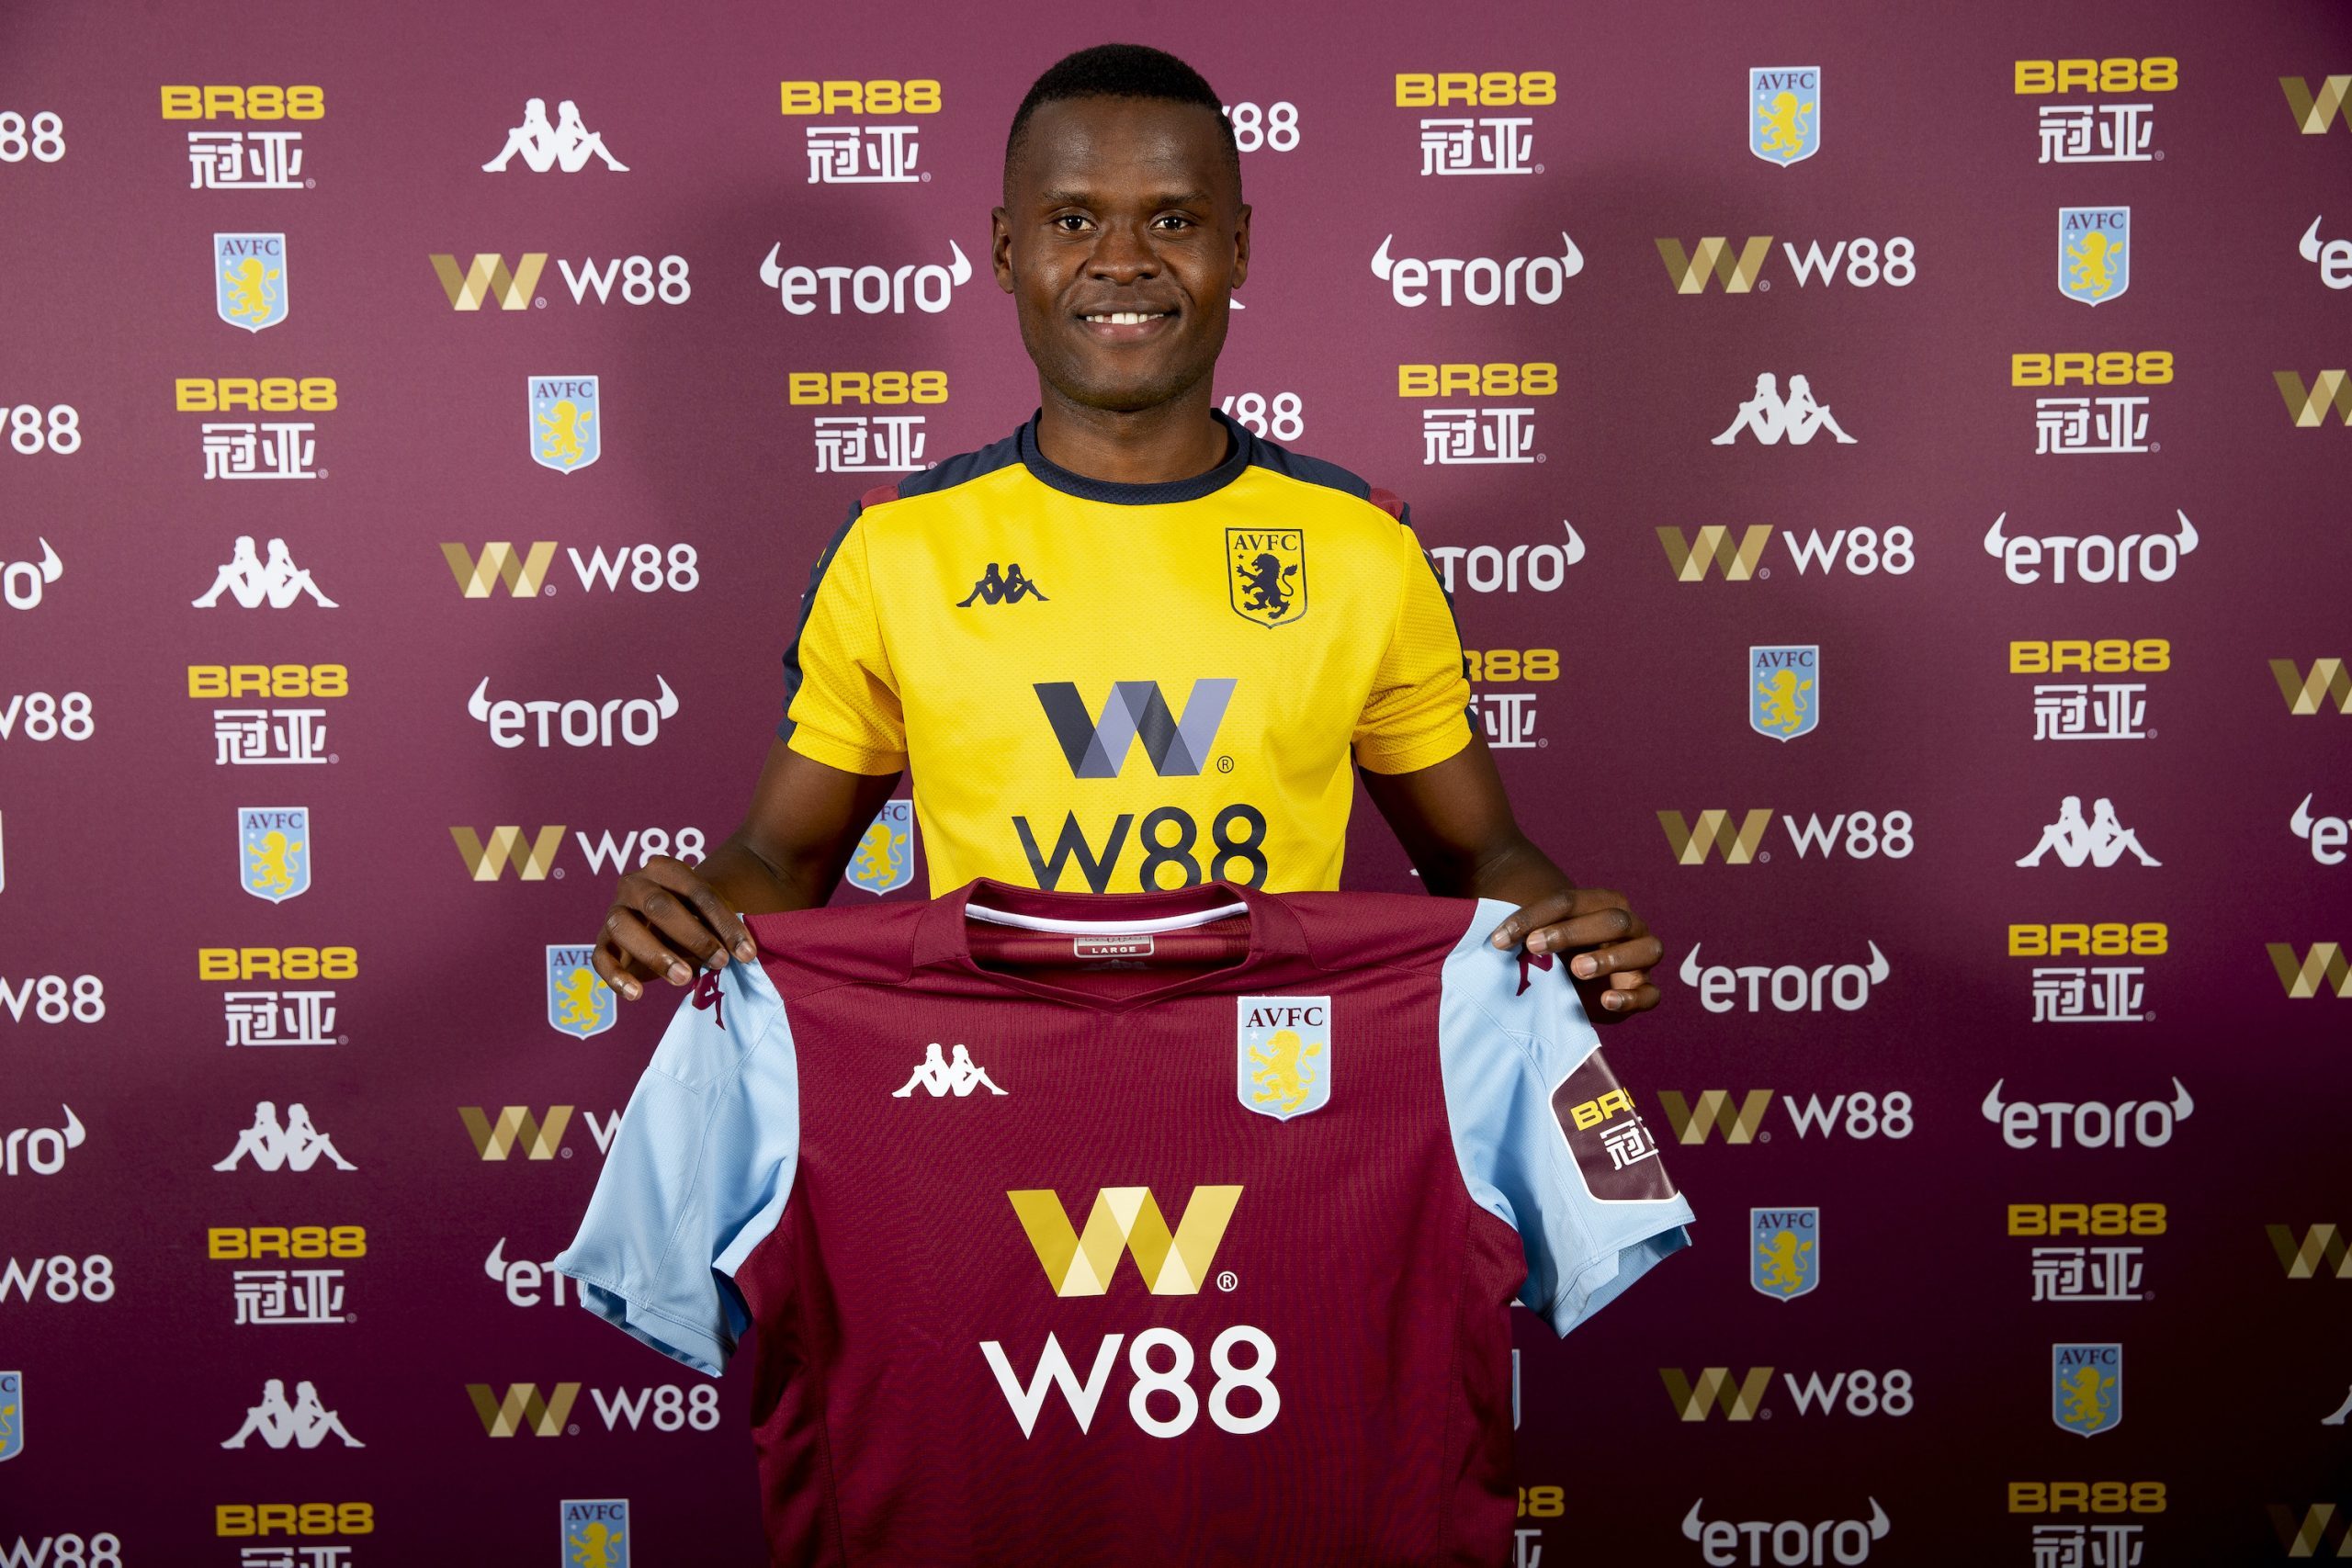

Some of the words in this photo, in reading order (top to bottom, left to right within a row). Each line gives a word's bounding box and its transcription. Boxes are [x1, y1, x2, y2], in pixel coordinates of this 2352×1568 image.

[781, 79, 942, 115] BR88
[1396, 71, 1556, 107] BR88
[1756, 73, 1815, 90] AVFC
[2015, 57, 2178, 94] BR88
[161, 85, 324, 119] BR88
[0, 111, 65, 162] 88
[1222, 102, 1300, 152] 88
[1420, 118, 1533, 175] 冠亚
[2039, 104, 2154, 164] 冠亚
[188, 132, 304, 188] 冠亚
[807, 126, 920, 184] 冠亚
[2065, 212, 2124, 231] AVFC
[221, 240, 280, 257] AVFC
[1783, 237, 1916, 288] W88
[558, 255, 691, 305] W88
[536, 382, 594, 400] AVFC
[789, 371, 948, 405] BR88
[1398, 363, 1558, 397] BR88
[2012, 351, 2174, 387] BR88
[175, 378, 337, 412] BR88
[1221, 392, 1304, 441] 88
[0, 404, 81, 454] 88
[815, 416, 926, 472] 冠亚
[1423, 408, 1534, 465] 冠亚
[2036, 397, 2150, 454] 冠亚
[202, 423, 317, 479] 冠亚
[1234, 532, 1298, 551] AVFC
[1782, 525, 1915, 575] W88
[567, 544, 699, 592] W88
[1423, 544, 1566, 593] Toro
[1464, 649, 1560, 682] 88
[1756, 651, 1814, 668] AVFC
[2010, 638, 2170, 673] BR88
[188, 664, 348, 698] BR88
[1470, 694, 1537, 748] 亚
[2033, 683, 2147, 740] 冠亚
[214, 709, 327, 765] 冠亚
[245, 813, 303, 830] AVFC
[879, 805, 908, 821] FC
[1783, 810, 1914, 859] W88
[576, 828, 706, 875] W88
[1012, 804, 1268, 893] W88
[553, 950, 594, 967] AVF
[1091, 946, 1137, 954] LARGE
[2008, 922, 2168, 956] BR88
[198, 947, 358, 980] BR88
[1246, 1006, 1324, 1027] AVFC
[2032, 967, 2145, 1022] 冠亚
[224, 991, 337, 1046] 冠亚
[1570, 1088, 1635, 1131] BR
[1783, 1091, 1914, 1139] W88
[1600, 1116, 1658, 1170] 冠
[209, 1225, 367, 1259] BR88
[1757, 1213, 1814, 1229] AVFC
[2008, 1203, 2166, 1235] BR88
[0, 1255, 115, 1303] W88
[233, 1269, 345, 1325] 冠亚
[2031, 1247, 2143, 1301] 冠亚
[2059, 1348, 2117, 1366] AVFC
[979, 1325, 1281, 1439] W88
[1784, 1370, 1913, 1416] W88
[591, 1384, 720, 1431] W88
[216, 1503, 374, 1537] BR88
[568, 1504, 624, 1521] AVFC
[2009, 1483, 2165, 1513] BR88
